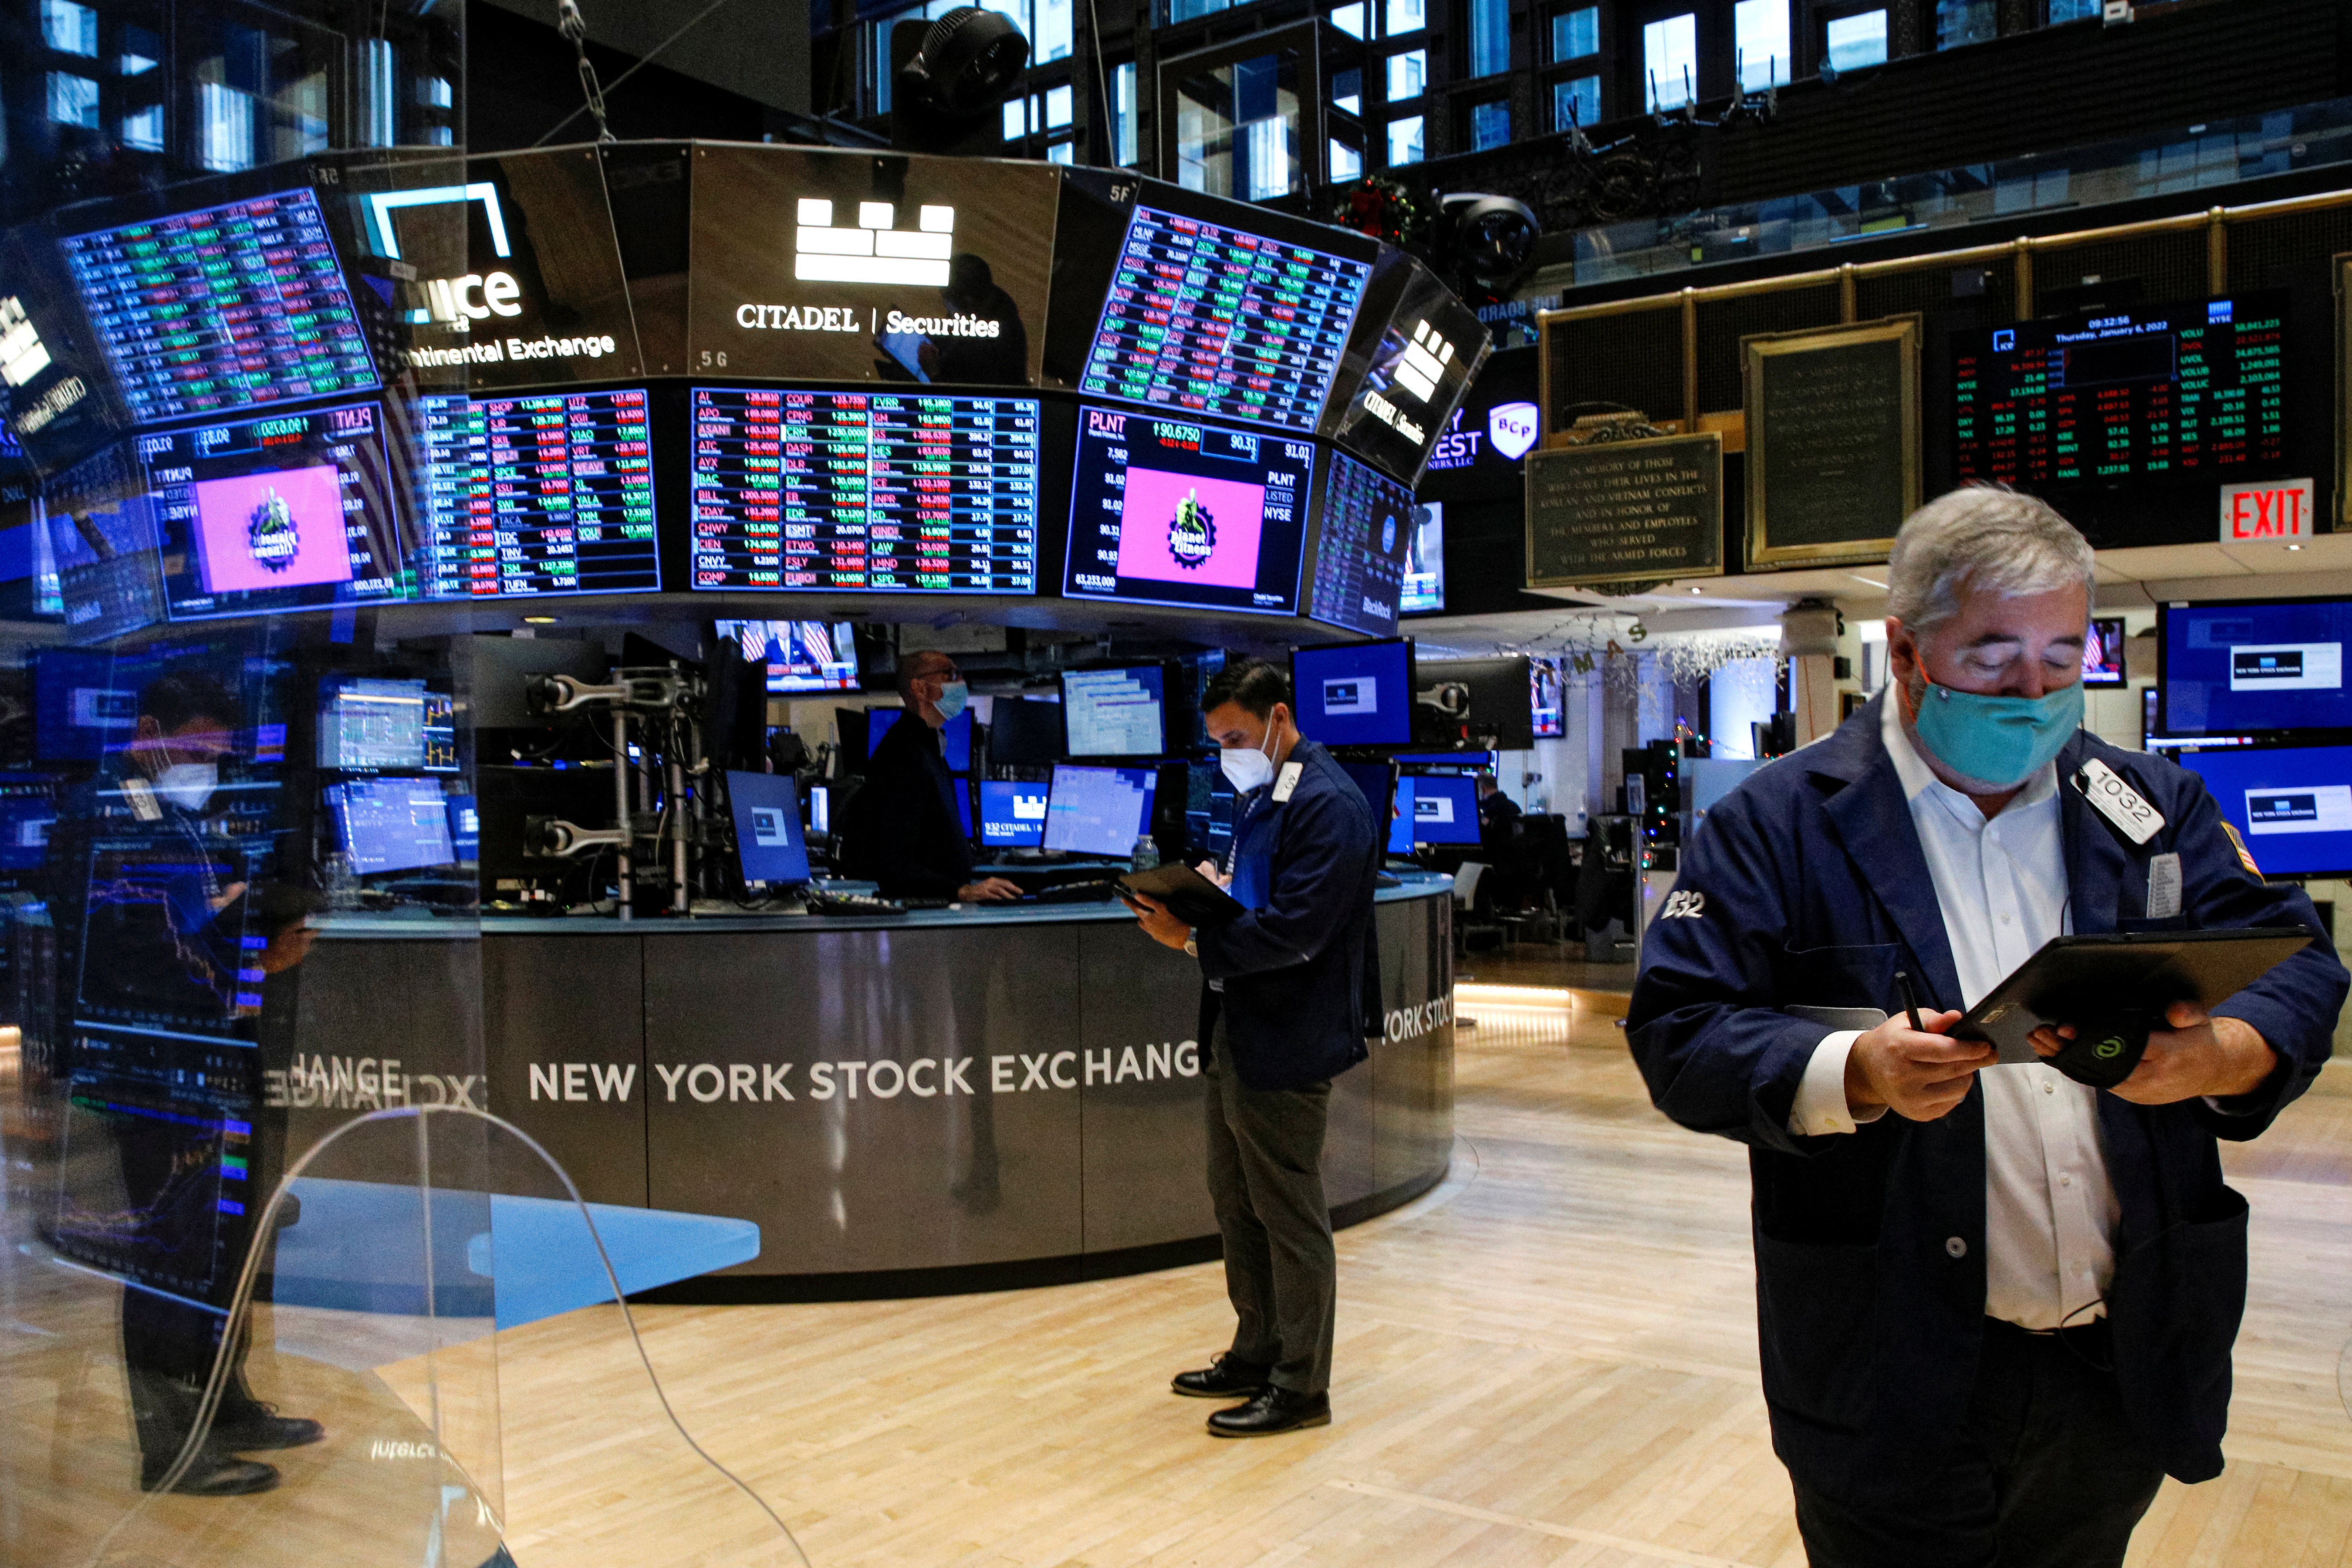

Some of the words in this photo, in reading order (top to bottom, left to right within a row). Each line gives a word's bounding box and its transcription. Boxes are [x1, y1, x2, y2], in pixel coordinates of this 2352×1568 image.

[1109, 185, 1129, 201] 5F
[737, 304, 860, 333] CITADEL
[886, 310, 1000, 338] Securities
[2208, 314, 2232, 325] NYSE
[2055, 331, 2097, 343] Thursday,
[2099, 327, 2134, 338] January
[2146, 320, 2168, 332] 2022
[2180, 328, 2204, 339] VOLU
[507, 335, 615, 358] Exchange
[1958, 380, 1977, 390] NYSE
[786, 394, 813, 405] COUR
[1958, 393, 1974, 402] NYA
[489, 402, 513, 412] SHOP
[2180, 406, 2196, 416] VIX
[873, 413, 888, 422] GM
[1498, 418, 1531, 438] BCP
[2180, 419, 2198, 428] RUT
[873, 430, 886, 439] GS
[1090, 411, 1126, 433] PLNT
[1160, 422, 1200, 443] 90.6750
[1285, 443, 1310, 460] 91.01
[786, 443, 813, 453] DASH
[1431, 431, 1482, 459] EST
[572, 446, 590, 455] VRT
[699, 457, 717, 467] AYX
[873, 462, 889, 471] IBM
[786, 476, 800, 485] DV
[873, 478, 887, 487] ICE
[1268, 471, 1296, 487] PLNT
[496, 484, 512, 492] SSU
[576, 495, 599, 504] YALA
[698, 490, 718, 499] BILL
[1266, 490, 1293, 504] LISTED
[699, 507, 724, 516] CDAY
[872, 510, 885, 520] KD
[1264, 506, 1291, 522] NYSE
[2233, 488, 2305, 539] EXIT
[698, 523, 728, 533] CHWY
[1170, 528, 1206, 545] planet
[699, 539, 720, 548] CIEN
[872, 542, 893, 552] LAW
[1174, 543, 1212, 556] fitness
[698, 556, 725, 565] CNVY
[872, 574, 895, 584] LSPD
[2096, 770, 2151, 823] 1032
[529, 1063, 636, 1102] NEW
[655, 1062, 794, 1103] YORK
[809, 1057, 976, 1100] STOCK
[990, 1040, 1200, 1093] EXCHANG
